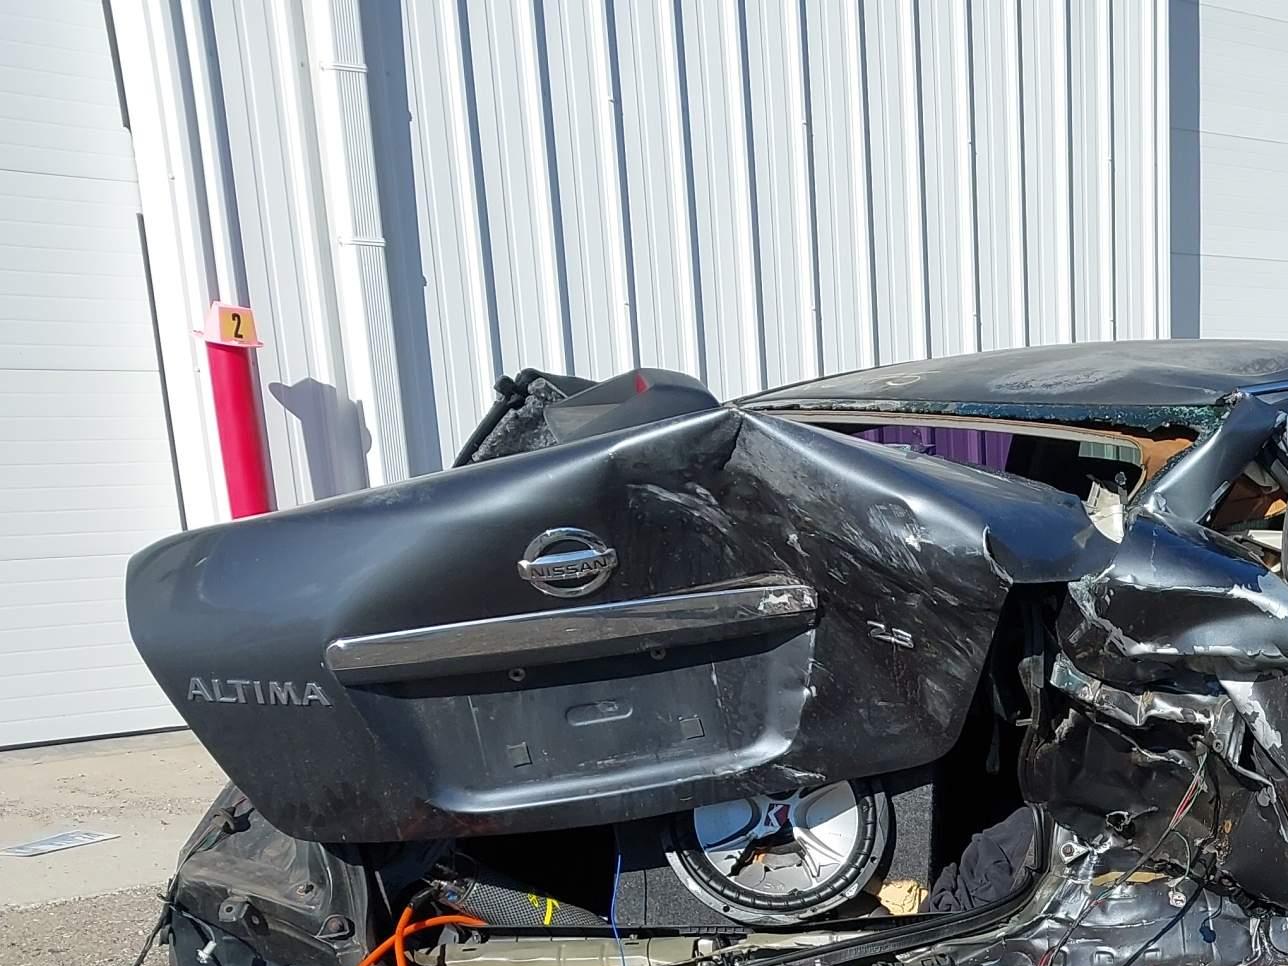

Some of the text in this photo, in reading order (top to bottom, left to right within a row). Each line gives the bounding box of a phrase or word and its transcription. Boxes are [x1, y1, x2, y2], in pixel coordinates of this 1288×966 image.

[231, 313, 243, 338] 2
[531, 557, 607, 577] NISSAN
[186, 676, 333, 708] ALTIMA
